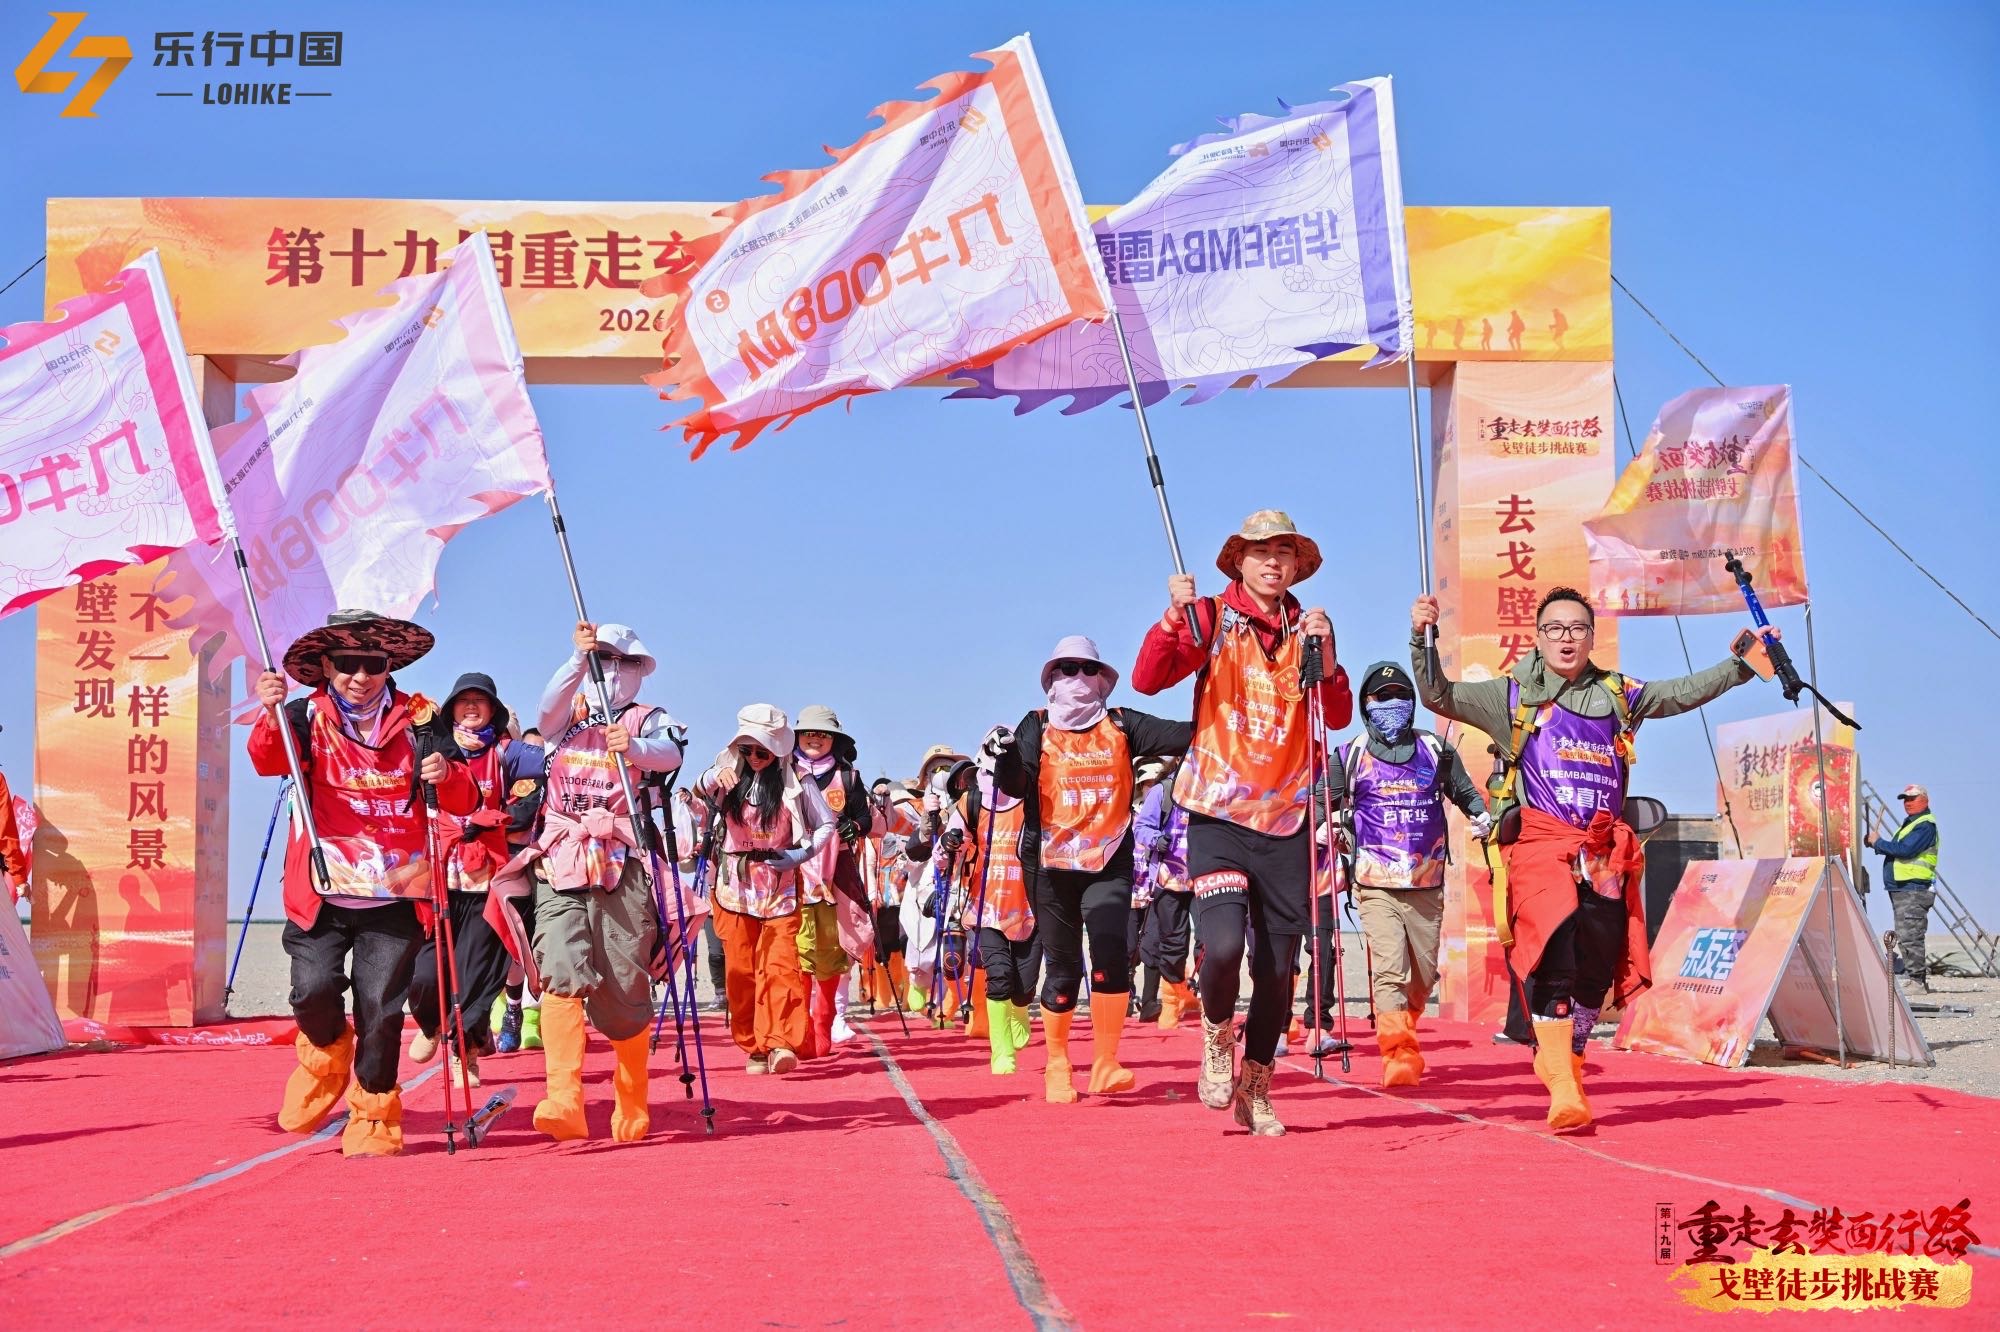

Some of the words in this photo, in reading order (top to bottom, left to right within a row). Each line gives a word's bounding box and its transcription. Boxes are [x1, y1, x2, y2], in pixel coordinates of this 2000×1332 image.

[1501, 442, 1588, 455] 戈壁徒步挑战赛
[126, 592, 170, 870] 不一样的风景
